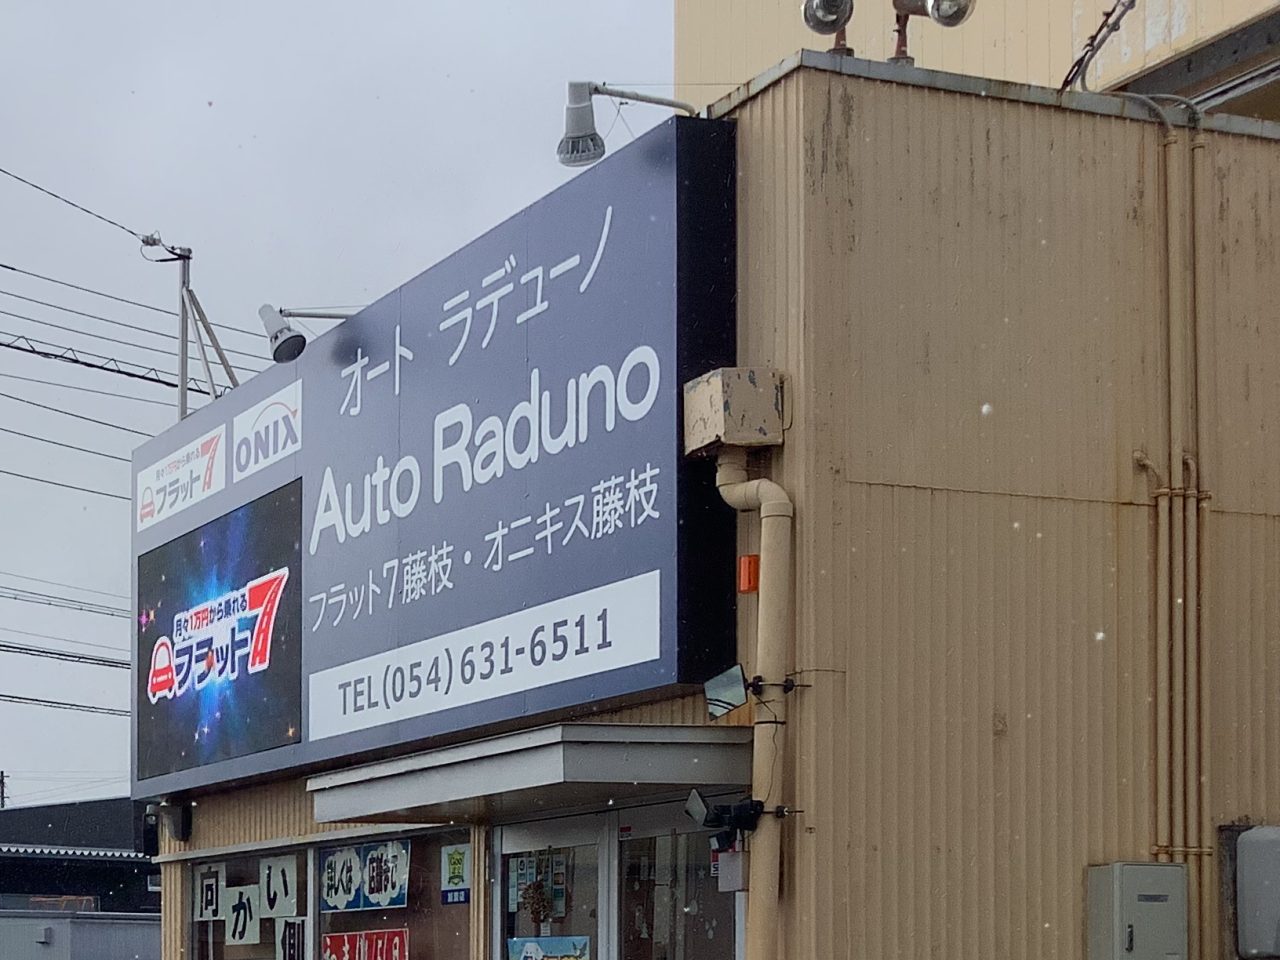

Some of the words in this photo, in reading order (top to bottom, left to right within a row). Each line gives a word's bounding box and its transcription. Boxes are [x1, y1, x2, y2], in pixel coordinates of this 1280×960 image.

[339, 324, 414, 416] オート
[439, 205, 612, 367] ラデューノ
[235, 414, 299, 473] ONIX
[309, 455, 421, 556] Auto
[433, 345, 661, 504] Raduno
